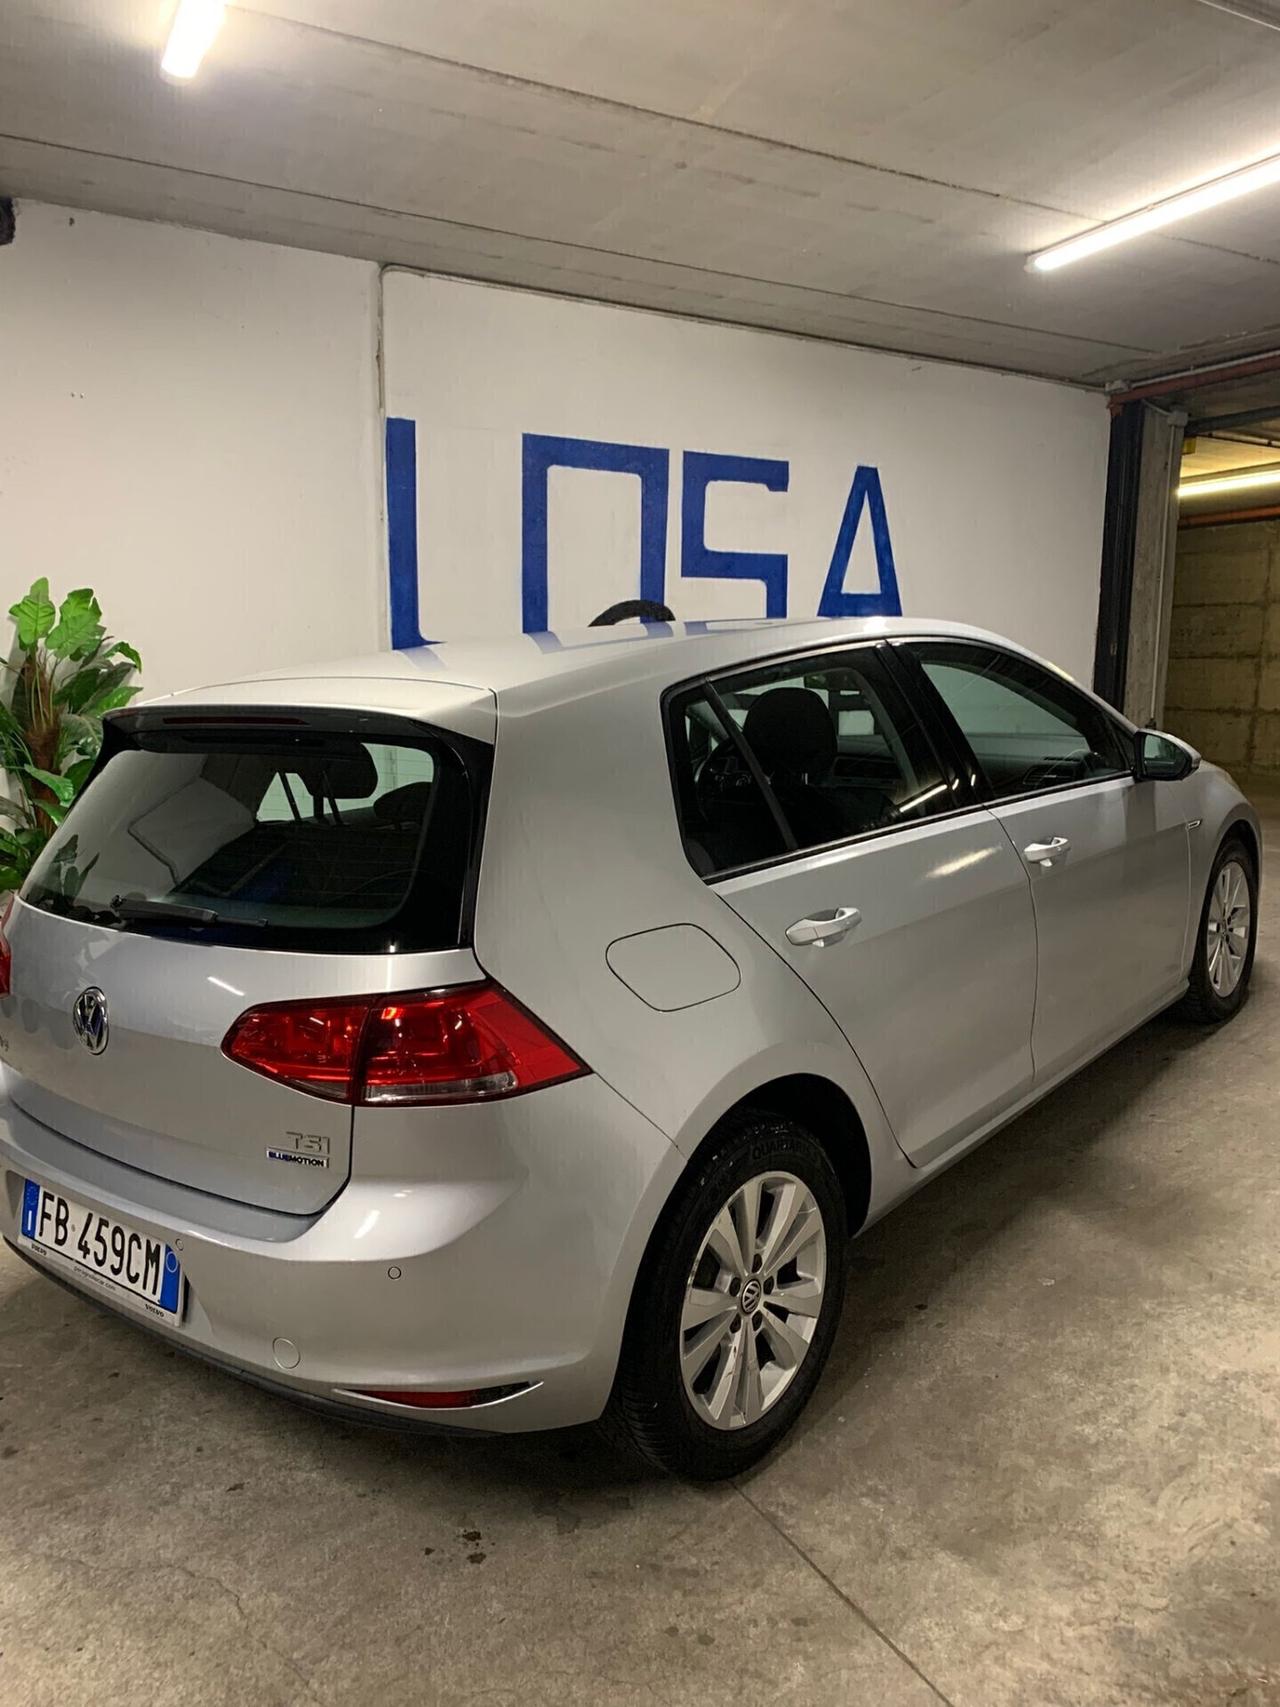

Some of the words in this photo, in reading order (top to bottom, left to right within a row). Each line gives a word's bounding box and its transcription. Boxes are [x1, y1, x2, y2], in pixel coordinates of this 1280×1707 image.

[385, 416, 904, 651] LOSA
[267, 1150, 325, 1168] BLUEMOTION
[285, 1130, 330, 1155] TSI
[38, 1190, 70, 1247] FB
[77, 1212, 162, 1296] 459CM
